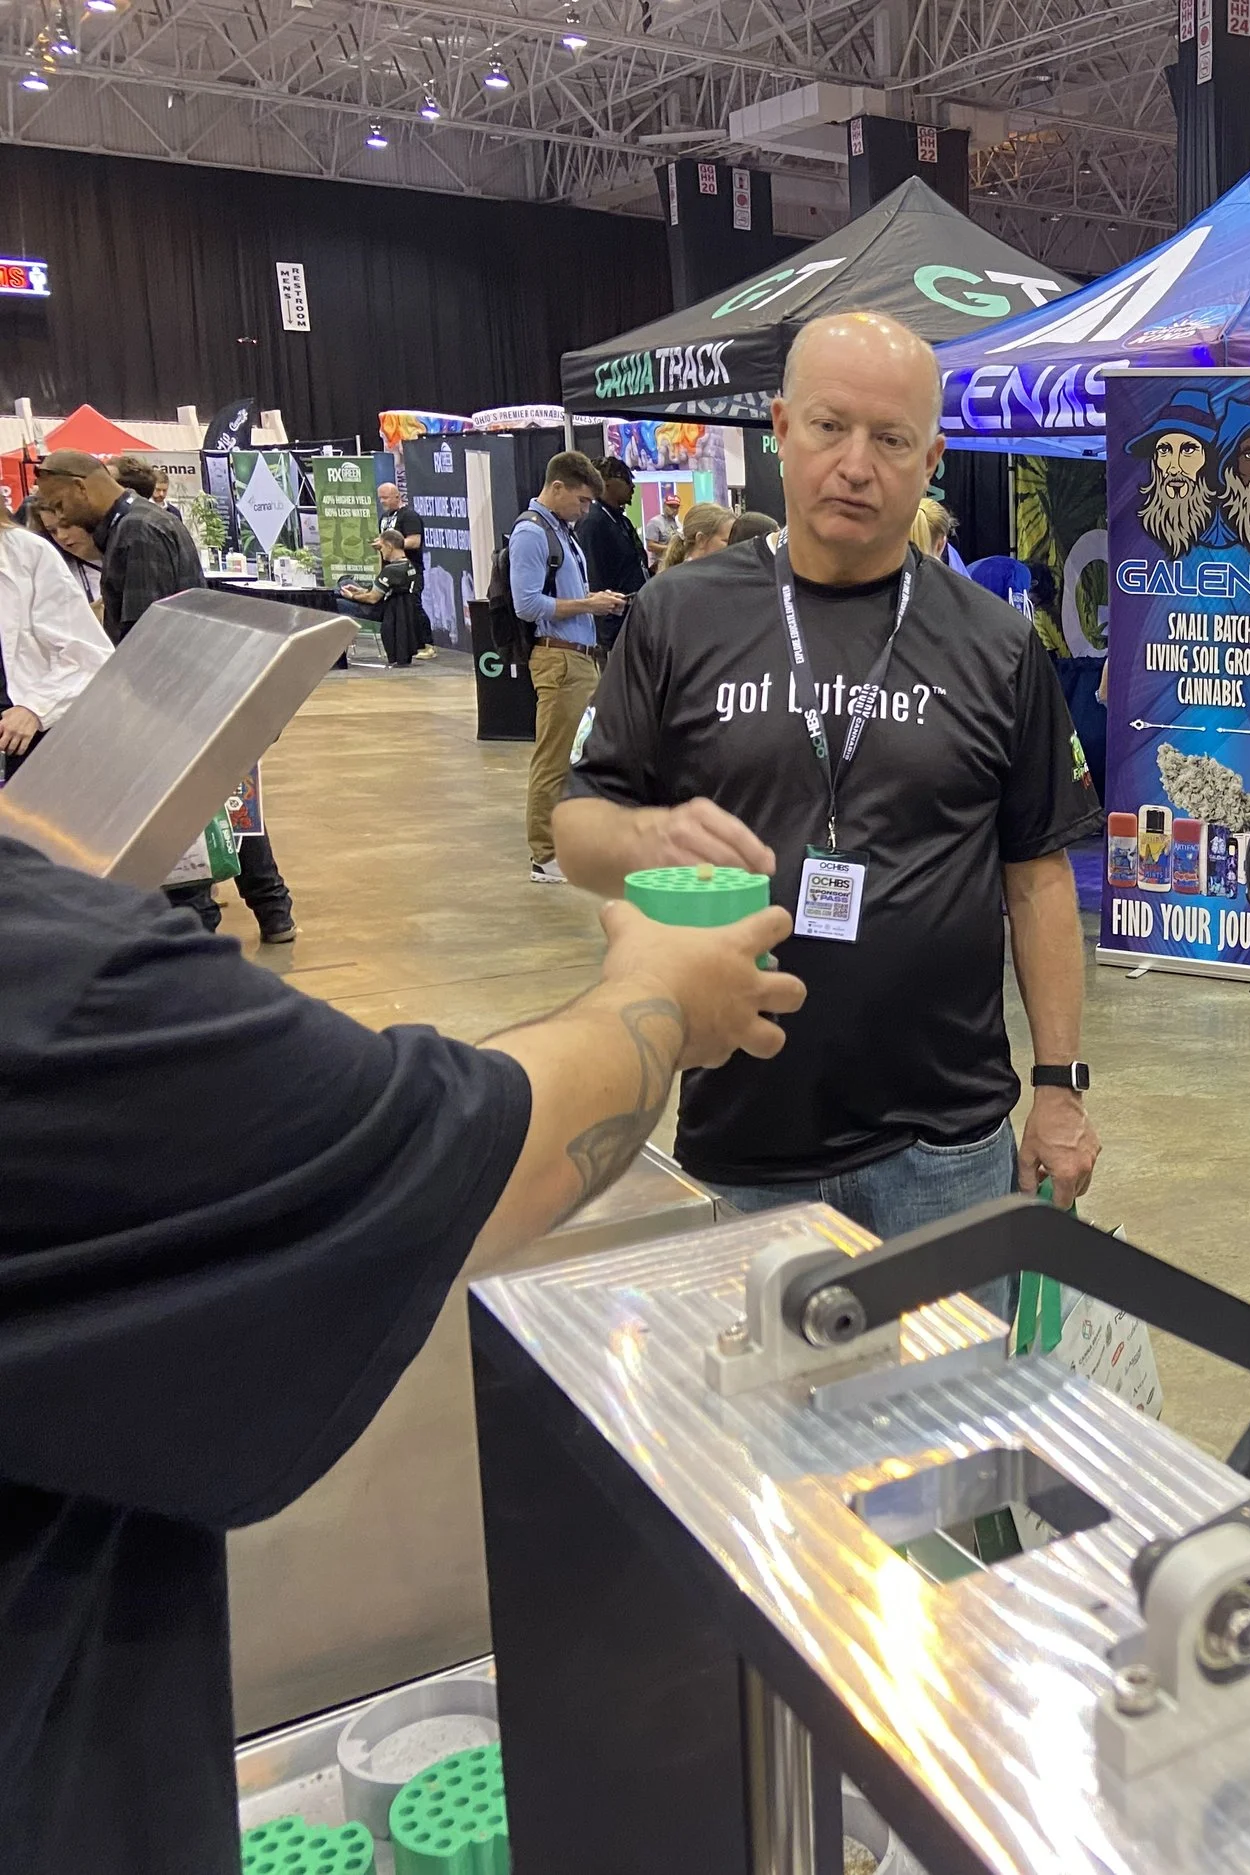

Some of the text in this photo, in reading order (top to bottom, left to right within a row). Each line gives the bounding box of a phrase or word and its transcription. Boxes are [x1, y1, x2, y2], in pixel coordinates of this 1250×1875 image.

[1182, 8, 1192, 22] HH
[1231, 3, 1249, 17] HH
[1181, 21, 1192, 40] 24
[1230, 18, 1249, 34] 24
[853, 141, 863, 154] 22
[920, 138, 935, 148] HH
[920, 149, 936, 161] 22
[701, 174, 715, 183] HH
[701, 183, 716, 193] 20
[280, 270, 292, 299] MENS
[711, 257, 847, 319] GT
[913, 264, 1061, 318] GT
[292, 267, 306, 328] RESTROOM
[655, 339, 735, 393] TRACK
[474, 411, 497, 426] OHIO'S
[499, 409, 529, 420] PREMIER
[529, 408, 564, 421] CANNABIS
[335, 495, 355, 505] HIGHER
[355, 495, 372, 505] YIELD
[413, 495, 435, 517] HARVEST
[338, 508, 352, 518] LESS
[352, 508, 371, 518] WATER
[423, 527, 446, 549] ELEVATE
[445, 528, 459, 550] YOUR
[1168, 612, 1209, 641] SMALL
[1146, 643, 1189, 673] LIVING
[1192, 645, 1220, 675] SOIL
[716, 673, 773, 722] got
[1177, 677, 1246, 708] CANNABIS.
[819, 862, 850, 872] OCHBS
[811, 876, 850, 889] OCHBS
[820, 894, 849, 904] PASS
[1112, 898, 1154, 939] FIND
[1160, 902, 1211, 946] YOUR
